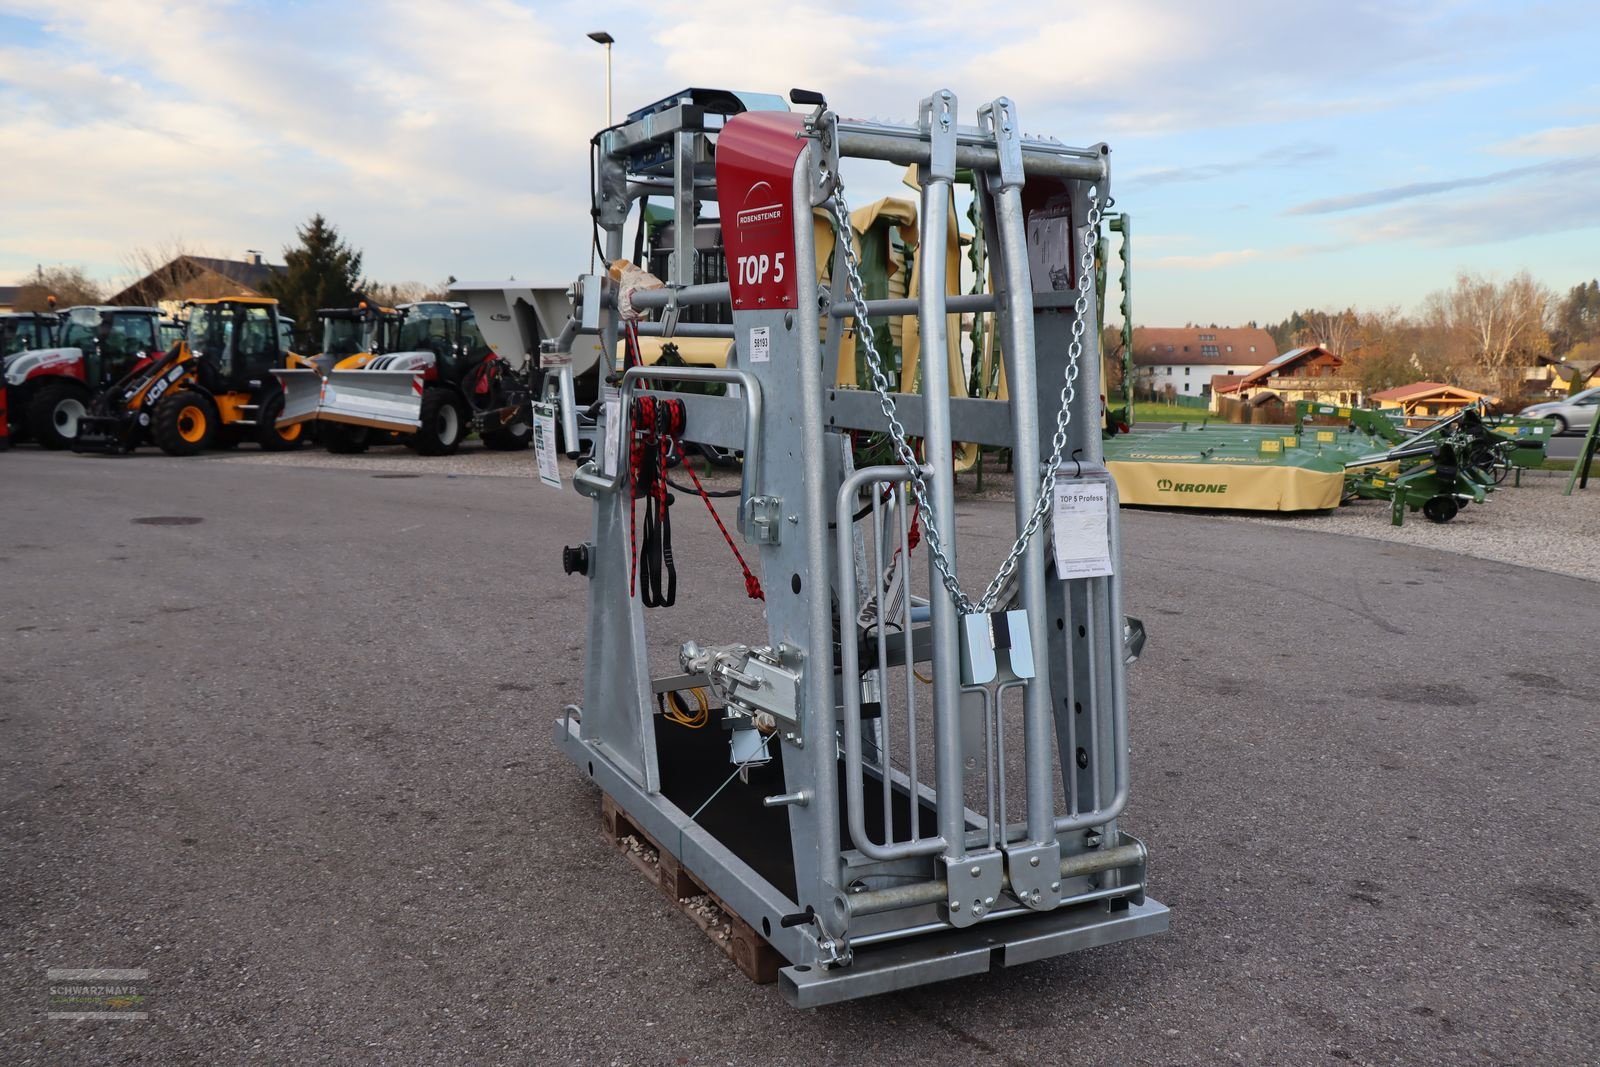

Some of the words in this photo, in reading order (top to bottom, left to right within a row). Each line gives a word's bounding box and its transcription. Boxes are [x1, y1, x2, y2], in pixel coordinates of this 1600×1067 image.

[739, 210, 781, 224] ROSENSTEINER
[737, 254, 770, 286] TOP
[773, 252, 785, 284] 5
[146, 378, 168, 405] JCB
[1173, 483, 1228, 494] KRONE
[1060, 495, 1073, 503] TOP
[1073, 495, 1078, 503] 5
[1078, 494, 1104, 503] Profess
